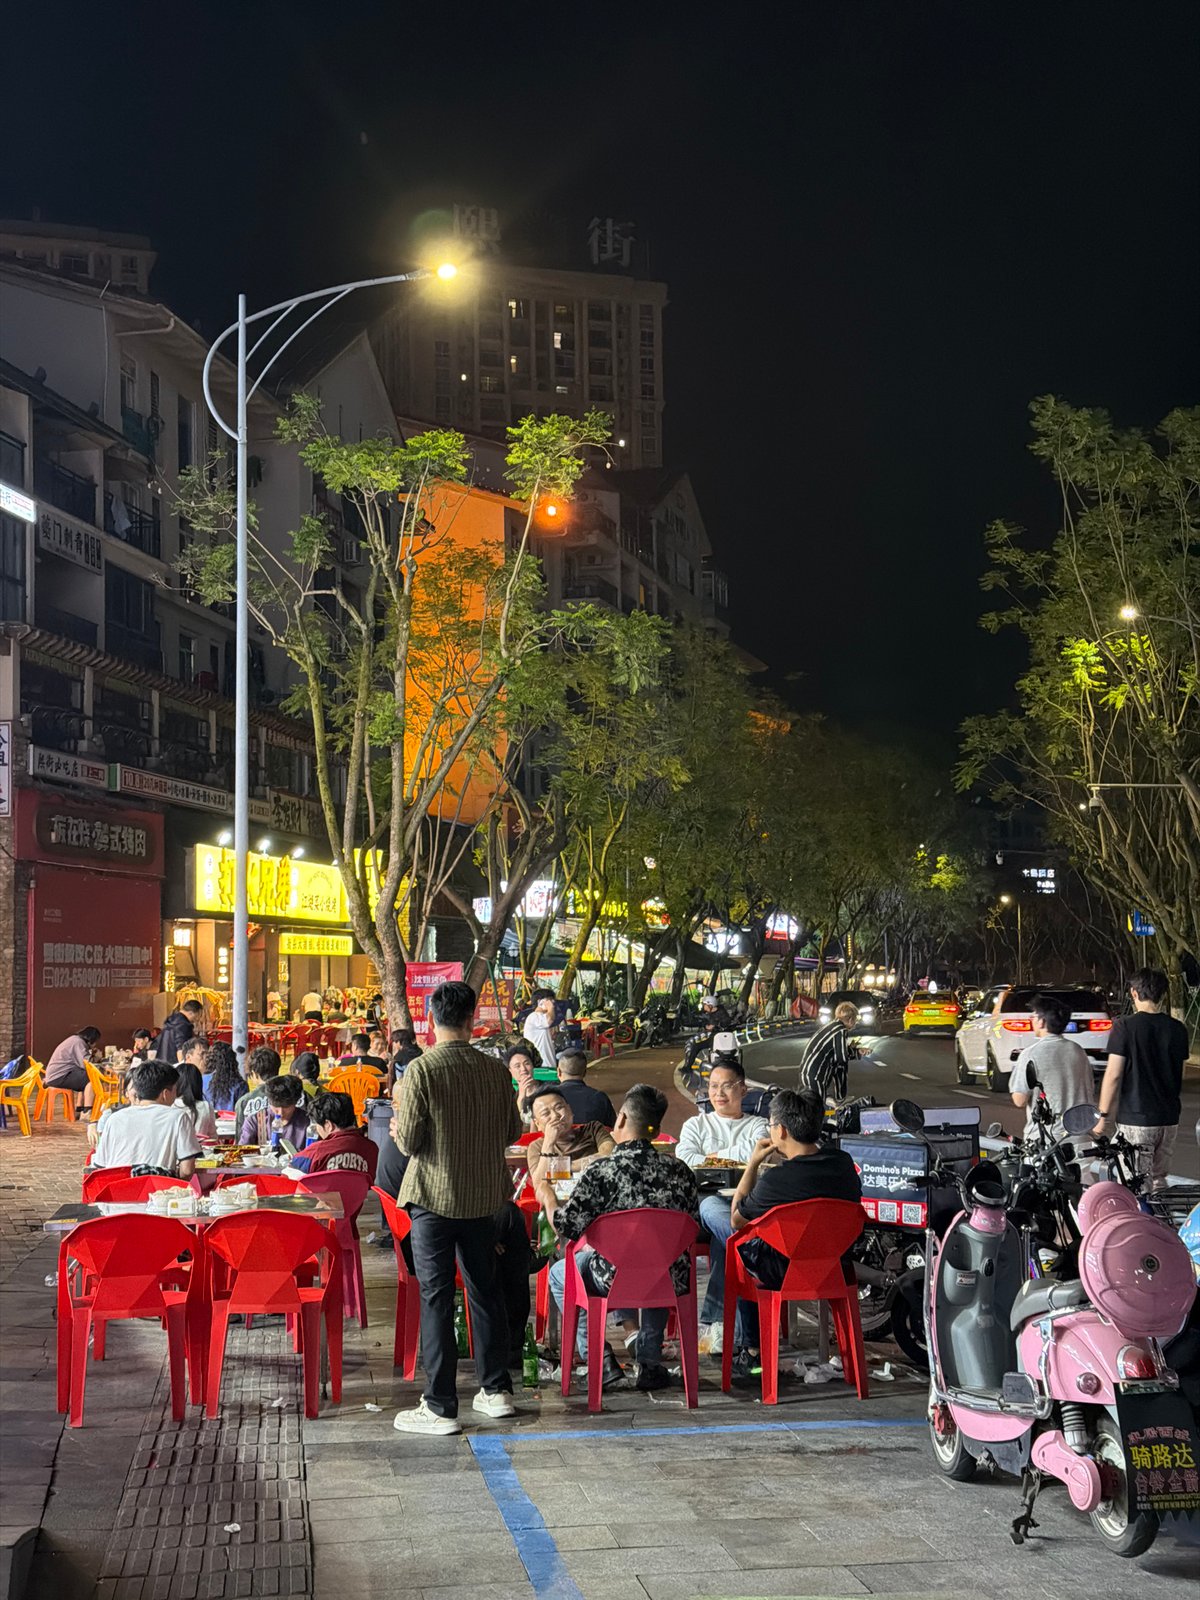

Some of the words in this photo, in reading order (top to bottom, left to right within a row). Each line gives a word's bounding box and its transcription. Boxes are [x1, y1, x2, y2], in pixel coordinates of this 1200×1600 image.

[863, 1164, 900, 1175] Domino's
[902, 1167, 925, 1177] Pizza
[1129, 1442, 1196, 1470] 骑路达
